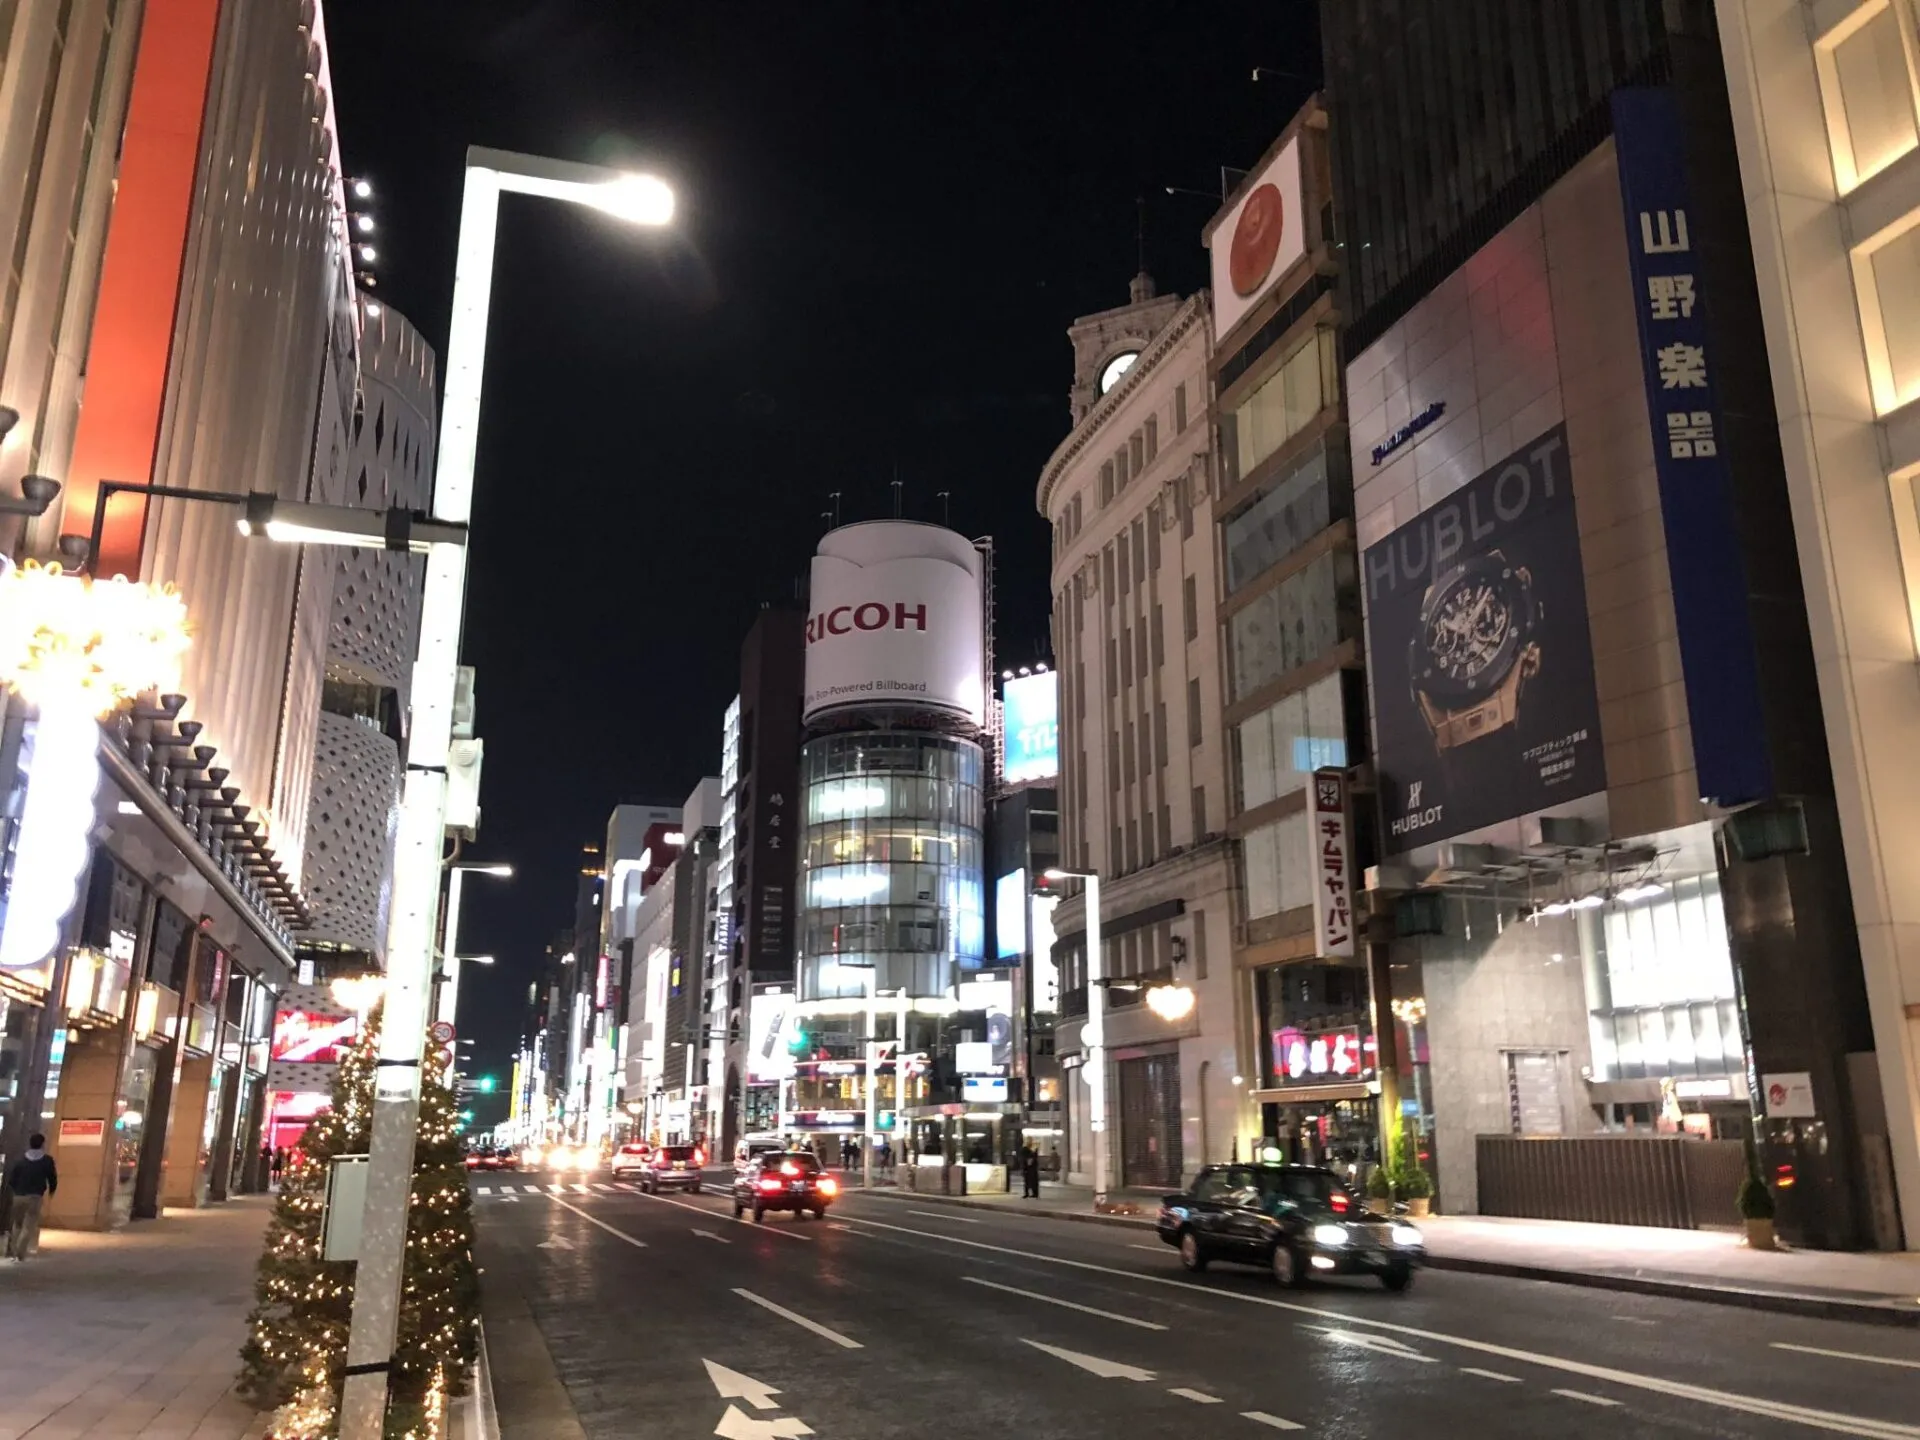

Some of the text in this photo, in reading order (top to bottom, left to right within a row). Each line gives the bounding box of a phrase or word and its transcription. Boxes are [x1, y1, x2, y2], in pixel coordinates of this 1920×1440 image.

[1640, 209, 1717, 459] 山野楽器
[1368, 436, 1562, 601] HUBLOT
[806, 602, 926, 644] RICOH
[875, 680, 927, 692] Billboard
[1391, 805, 1443, 835] HUBLOT
[1321, 819, 1350, 947] キムラヤのパン
